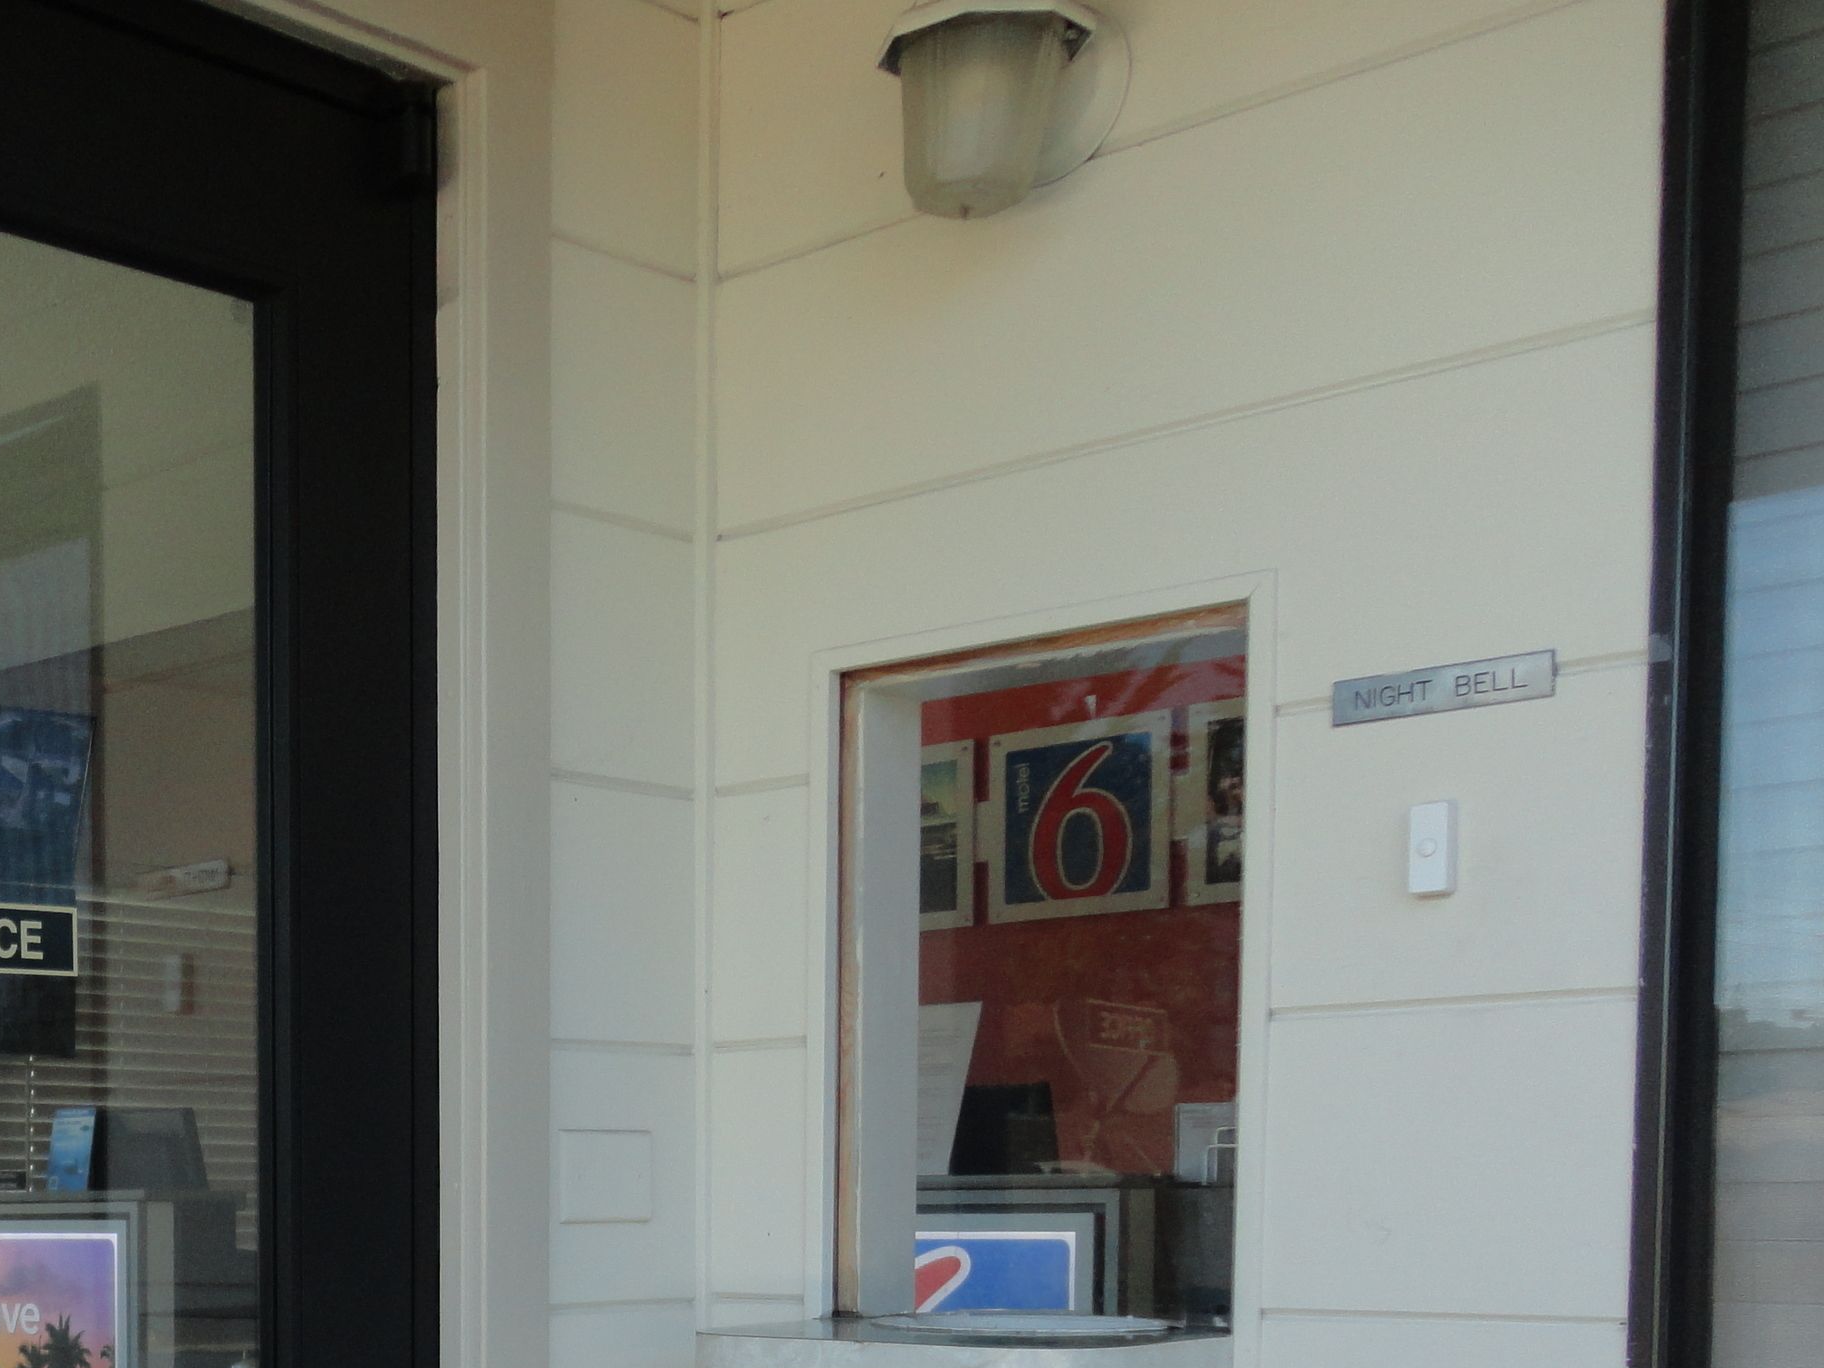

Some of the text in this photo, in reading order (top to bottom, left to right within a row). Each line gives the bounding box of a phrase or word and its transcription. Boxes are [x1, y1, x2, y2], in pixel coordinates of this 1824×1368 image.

[1354, 668, 1528, 711] NIGHT BELL
[1014, 741, 1132, 901] motel 6
